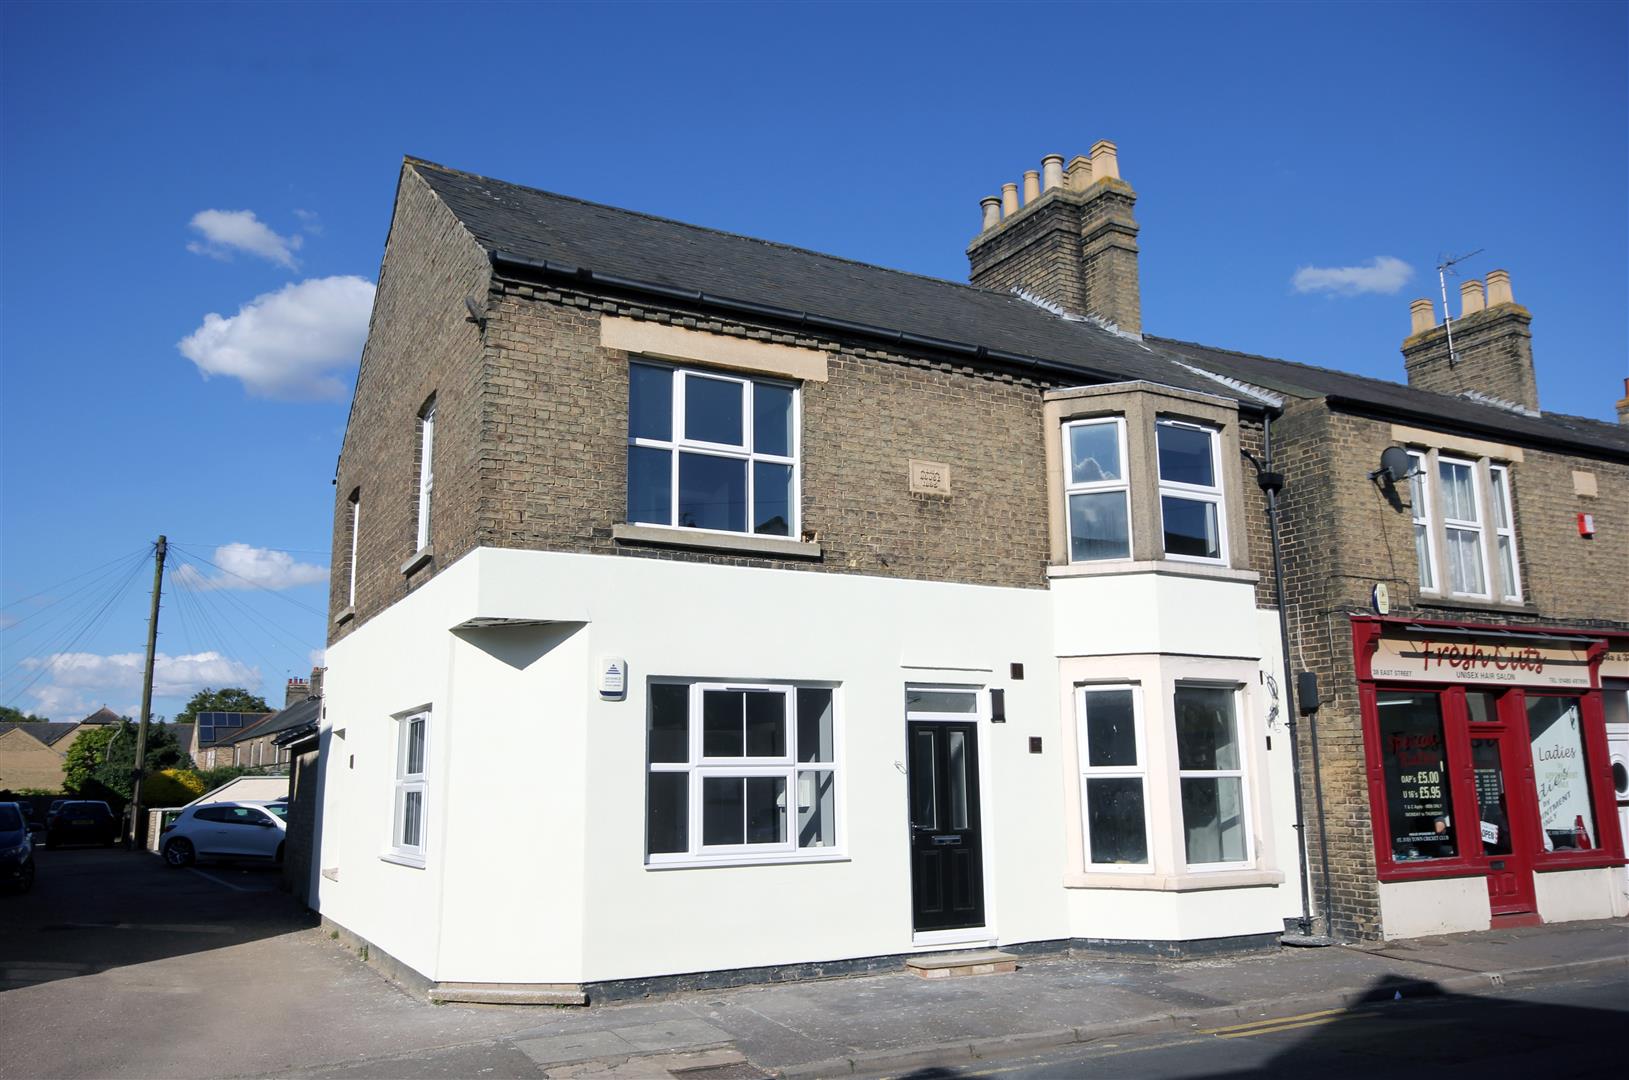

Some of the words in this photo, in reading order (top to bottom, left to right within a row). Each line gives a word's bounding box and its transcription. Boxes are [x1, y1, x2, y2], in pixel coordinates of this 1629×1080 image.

[1421, 641, 1490, 672] Fresh
[1495, 645, 1547, 674] Cuts
[1456, 671, 1479, 679] UNISEX
[1539, 744, 1576, 761] Ladies
[1400, 775, 1417, 784] OAP's
[1418, 771, 1439, 784] £5.00
[1420, 786, 1441, 799] £5.95
[1482, 829, 1494, 839] OPEN
